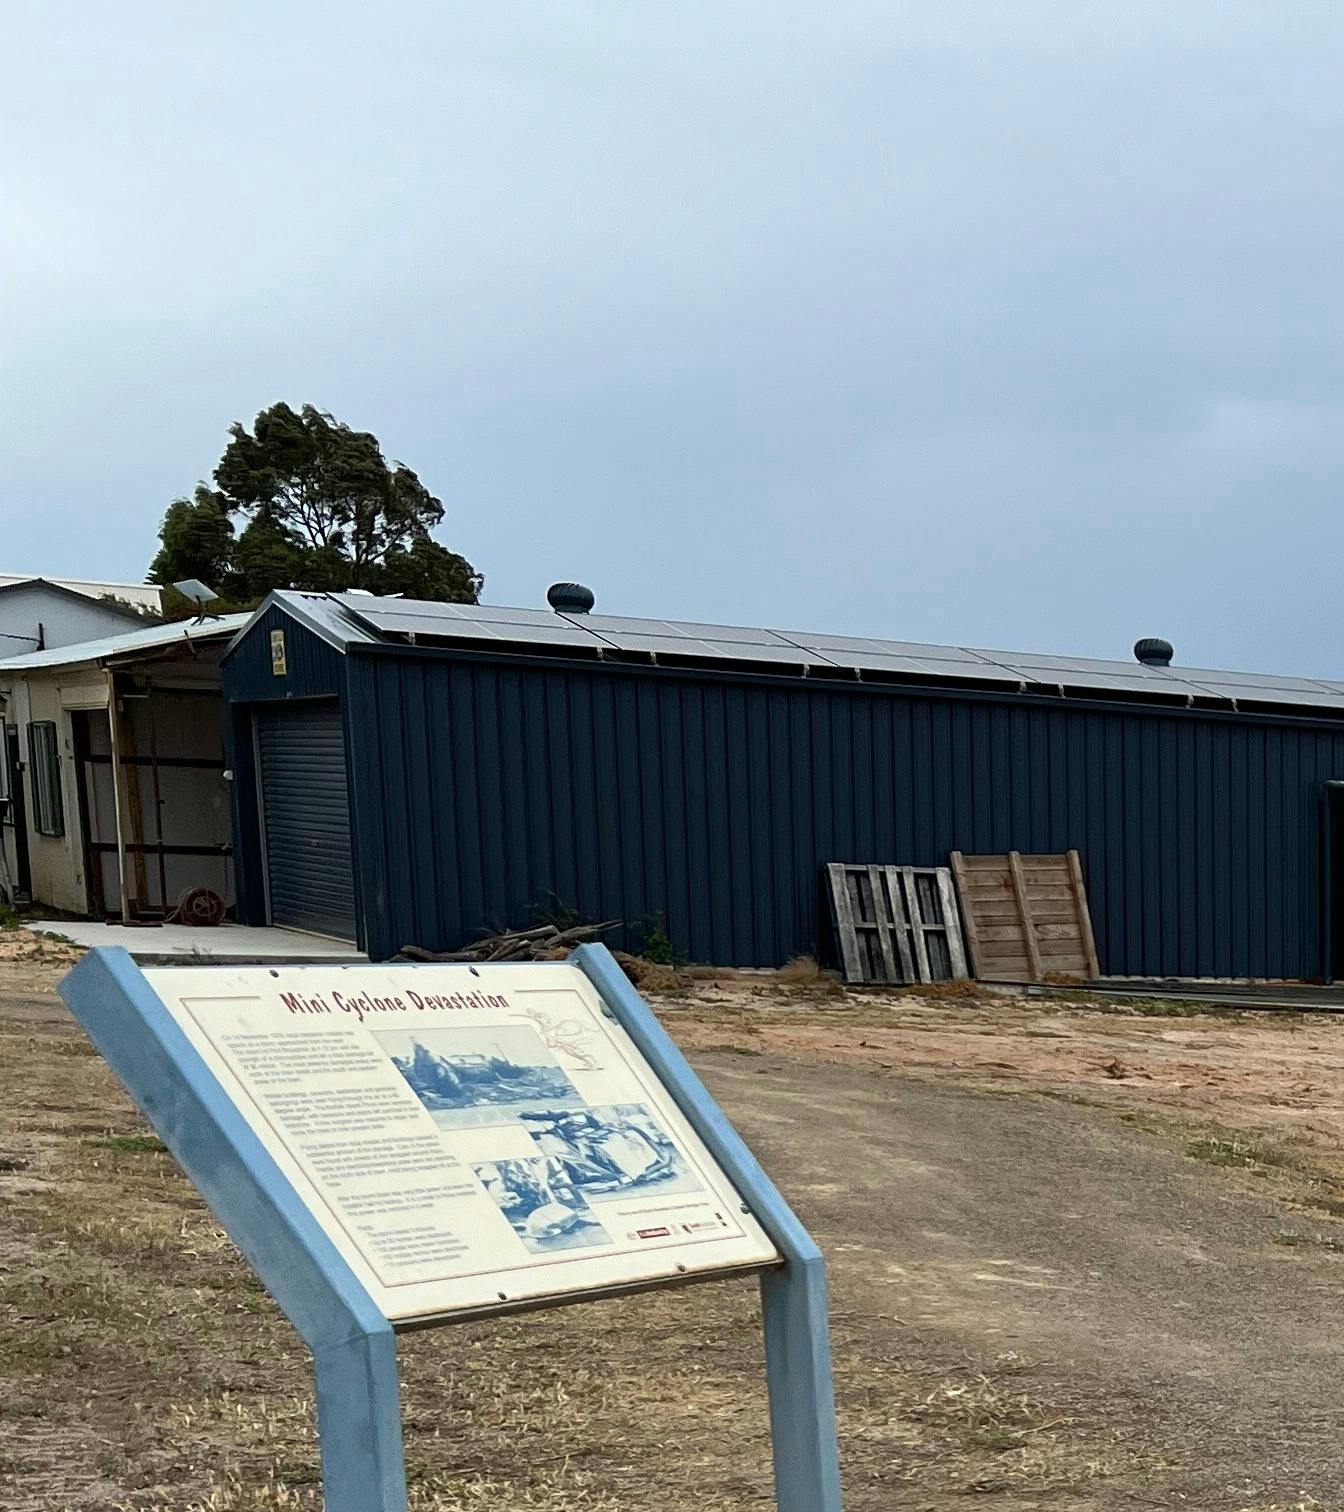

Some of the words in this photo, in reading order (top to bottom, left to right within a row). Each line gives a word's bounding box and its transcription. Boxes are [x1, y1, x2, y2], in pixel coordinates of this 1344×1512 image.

[279, 991, 331, 1014] Mini
[332, 990, 406, 1023] Cyclone
[406, 989, 511, 1011] Devastation
